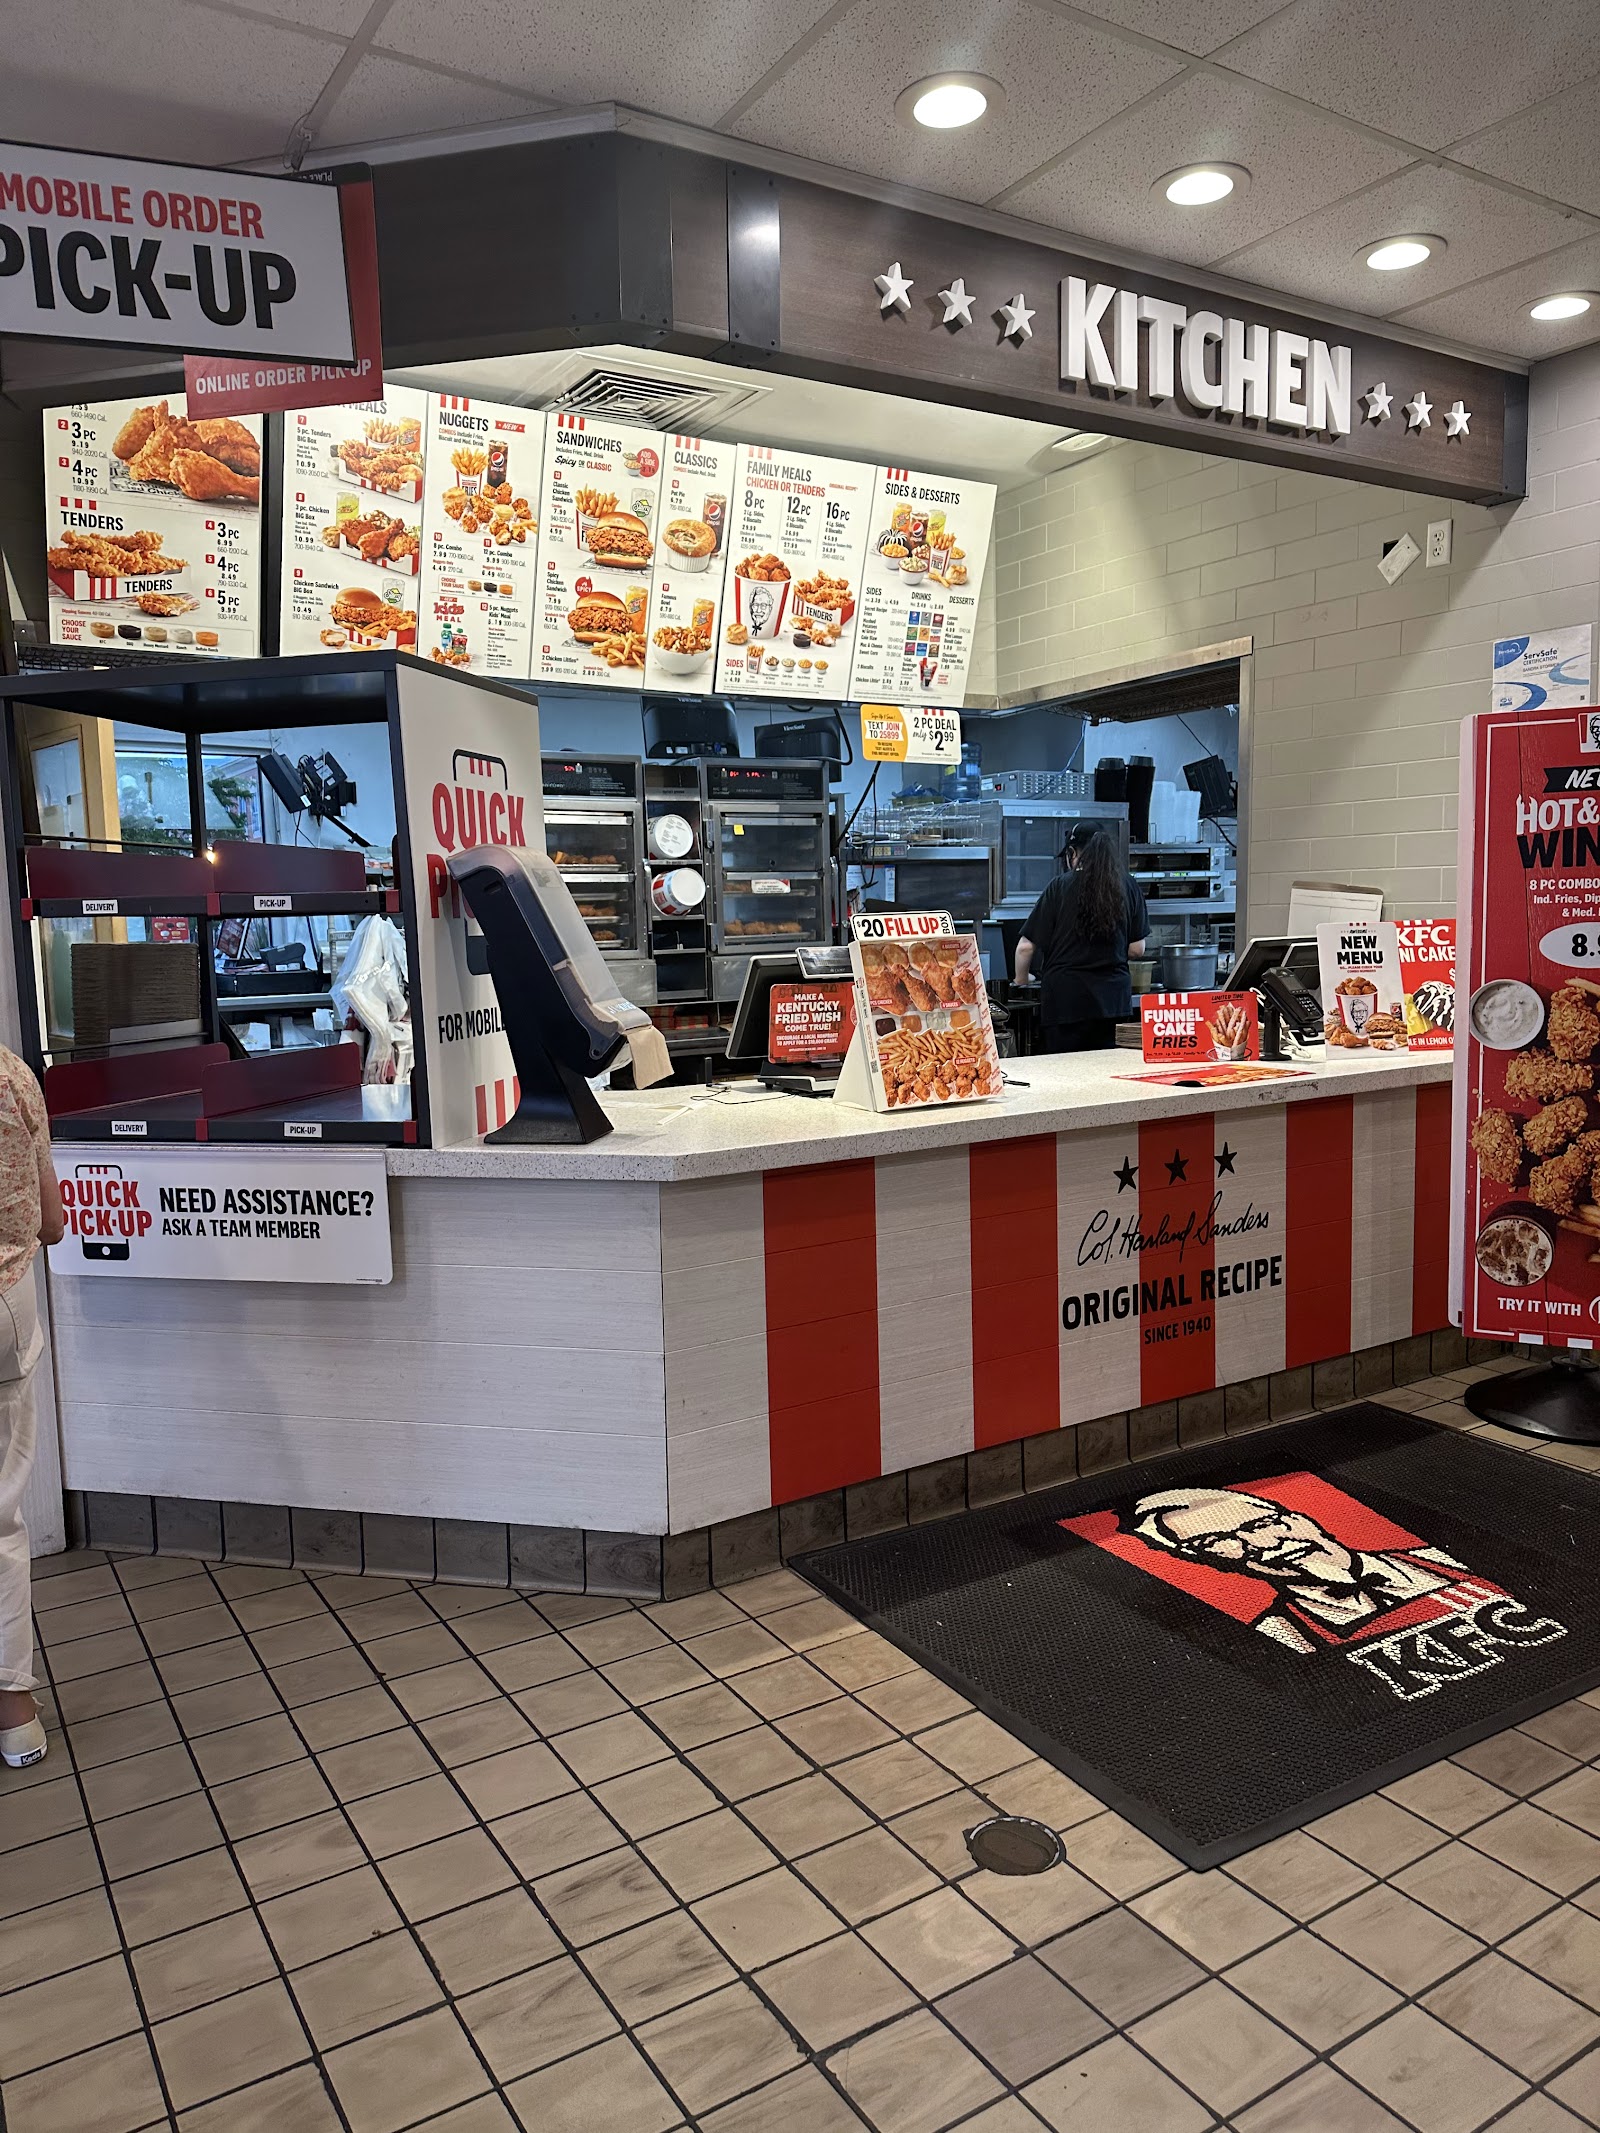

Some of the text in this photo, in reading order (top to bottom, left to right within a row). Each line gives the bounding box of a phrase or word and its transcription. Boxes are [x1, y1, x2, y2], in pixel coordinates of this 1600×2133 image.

[0, 171, 265, 239] MOBILE ORDER
[1060, 275, 1352, 438] KITCHEN
[195, 372, 250, 394] ONLINE
[255, 366, 307, 387] ORDER
[439, 411, 518, 432] NUGGETS NEW
[71, 422, 96, 440] 3 PC
[310, 428, 332, 438] Tenders
[71, 440, 89, 448] 9.19
[556, 430, 622, 453] SANDWICHES
[555, 446, 573, 454] Includes
[640, 450, 652, 459] ADD
[296, 460, 316, 469] 10.99
[554, 455, 612, 472] Spicy CLASSIC
[674, 450, 718, 470] CLASSICS
[72, 460, 98, 478] 4 PC
[746, 460, 812, 482] FAMILY MEALS
[72, 477, 94, 486] 10.99
[552, 481, 569, 489] Classic
[746, 476, 826, 498] CHICKEN OR TENDERS
[552, 488, 570, 496] Chicken
[885, 482, 960, 505] SIDES & DESSERTS
[551, 495, 574, 504] Sandwich
[744, 489, 765, 510] 8 PC
[787, 496, 812, 516] 12 PC
[295, 512, 305, 520] BIG
[308, 505, 330, 514] Chicken
[826, 501, 851, 521] 16 PC
[60, 510, 124, 531] TENDERS
[217, 522, 240, 540] 3 PC
[445, 544, 463, 552] Combo
[496, 549, 513, 558] Combo
[217, 556, 239, 573] 4 PC
[124, 579, 173, 593] TENDERS
[315, 581, 340, 590] Sandwich
[546, 578, 564, 586] Chicken
[546, 585, 568, 593] Sandwich
[576, 585, 592, 593] SPICY
[865, 587, 882, 596] SIDES
[217, 589, 240, 606] 5 PC
[911, 591, 932, 601] DRINKS
[948, 595, 975, 606] DESSERTS
[433, 602, 465, 615] kids
[660, 599, 671, 607] Bowl
[292, 606, 312, 614] 10.49
[805, 606, 833, 622] TENDERS
[61, 619, 86, 628] CHOOSE
[436, 614, 462, 623] MEAL
[61, 626, 79, 634] YOUR
[61, 633, 82, 641] SAUCE
[725, 658, 744, 668] SIDES
[1523, 655, 1558, 666] CERTIFICATION
[783, 723, 806, 732] ViewSonic
[867, 721, 900, 731] TEXT JOIN
[913, 716, 957, 731] 2 PC DEAL
[869, 730, 900, 739] TO 25899
[912, 729, 927, 742] only
[1564, 767, 1600, 790] NE
[432, 782, 527, 854] QUICK
[1529, 878, 1600, 891] 8 PC COMBO
[258, 898, 287, 909] PICK-UP
[1533, 894, 1553, 904] Ind.
[1555, 893, 1582, 904] Fries,
[85, 901, 115, 913] DELIVERY
[1562, 907, 1596, 917] & Med.
[884, 917, 919, 937] FILL
[920, 916, 941, 935] UP
[939, 915, 951, 934] BOX
[1340, 935, 1378, 950] NEW
[1397, 926, 1451, 947] KFC
[1336, 950, 1384, 966] MENU
[794, 993, 817, 1001] MAKE
[777, 1001, 840, 1013] KENTUCKY
[775, 1012, 841, 1024] FRIED WISH
[1143, 1008, 1205, 1024] FUNNEL
[437, 1006, 507, 1044] FOR MOBIL
[785, 1023, 832, 1032] COME TRUE!
[1152, 1022, 1196, 1037] CAKE
[1152, 1036, 1199, 1049] FRIES
[1418, 1037, 1425, 1046] IN
[1426, 1036, 1448, 1046] LEMON
[113, 1122, 144, 1134] DELIVERY
[289, 1125, 318, 1136] PICK-UP
[59, 1179, 141, 1209] QUICK
[159, 1187, 375, 1217] NEED ASSISTANCE?
[161, 1218, 321, 1239] ASK A TEAM MEMBER
[1077, 1190, 1269, 1267] Col. Harland Sanders
[1062, 1254, 1283, 1331] ORIGINAL RECIPE
[1497, 1297, 1525, 1312] TRY
[1528, 1299, 1541, 1313] IT
[1544, 1301, 1582, 1317] WITH
[1144, 1315, 1212, 1345] SINCE 1940
[1346, 1595, 1569, 1702] KFC
[22, 1751, 41, 1764] Keds
